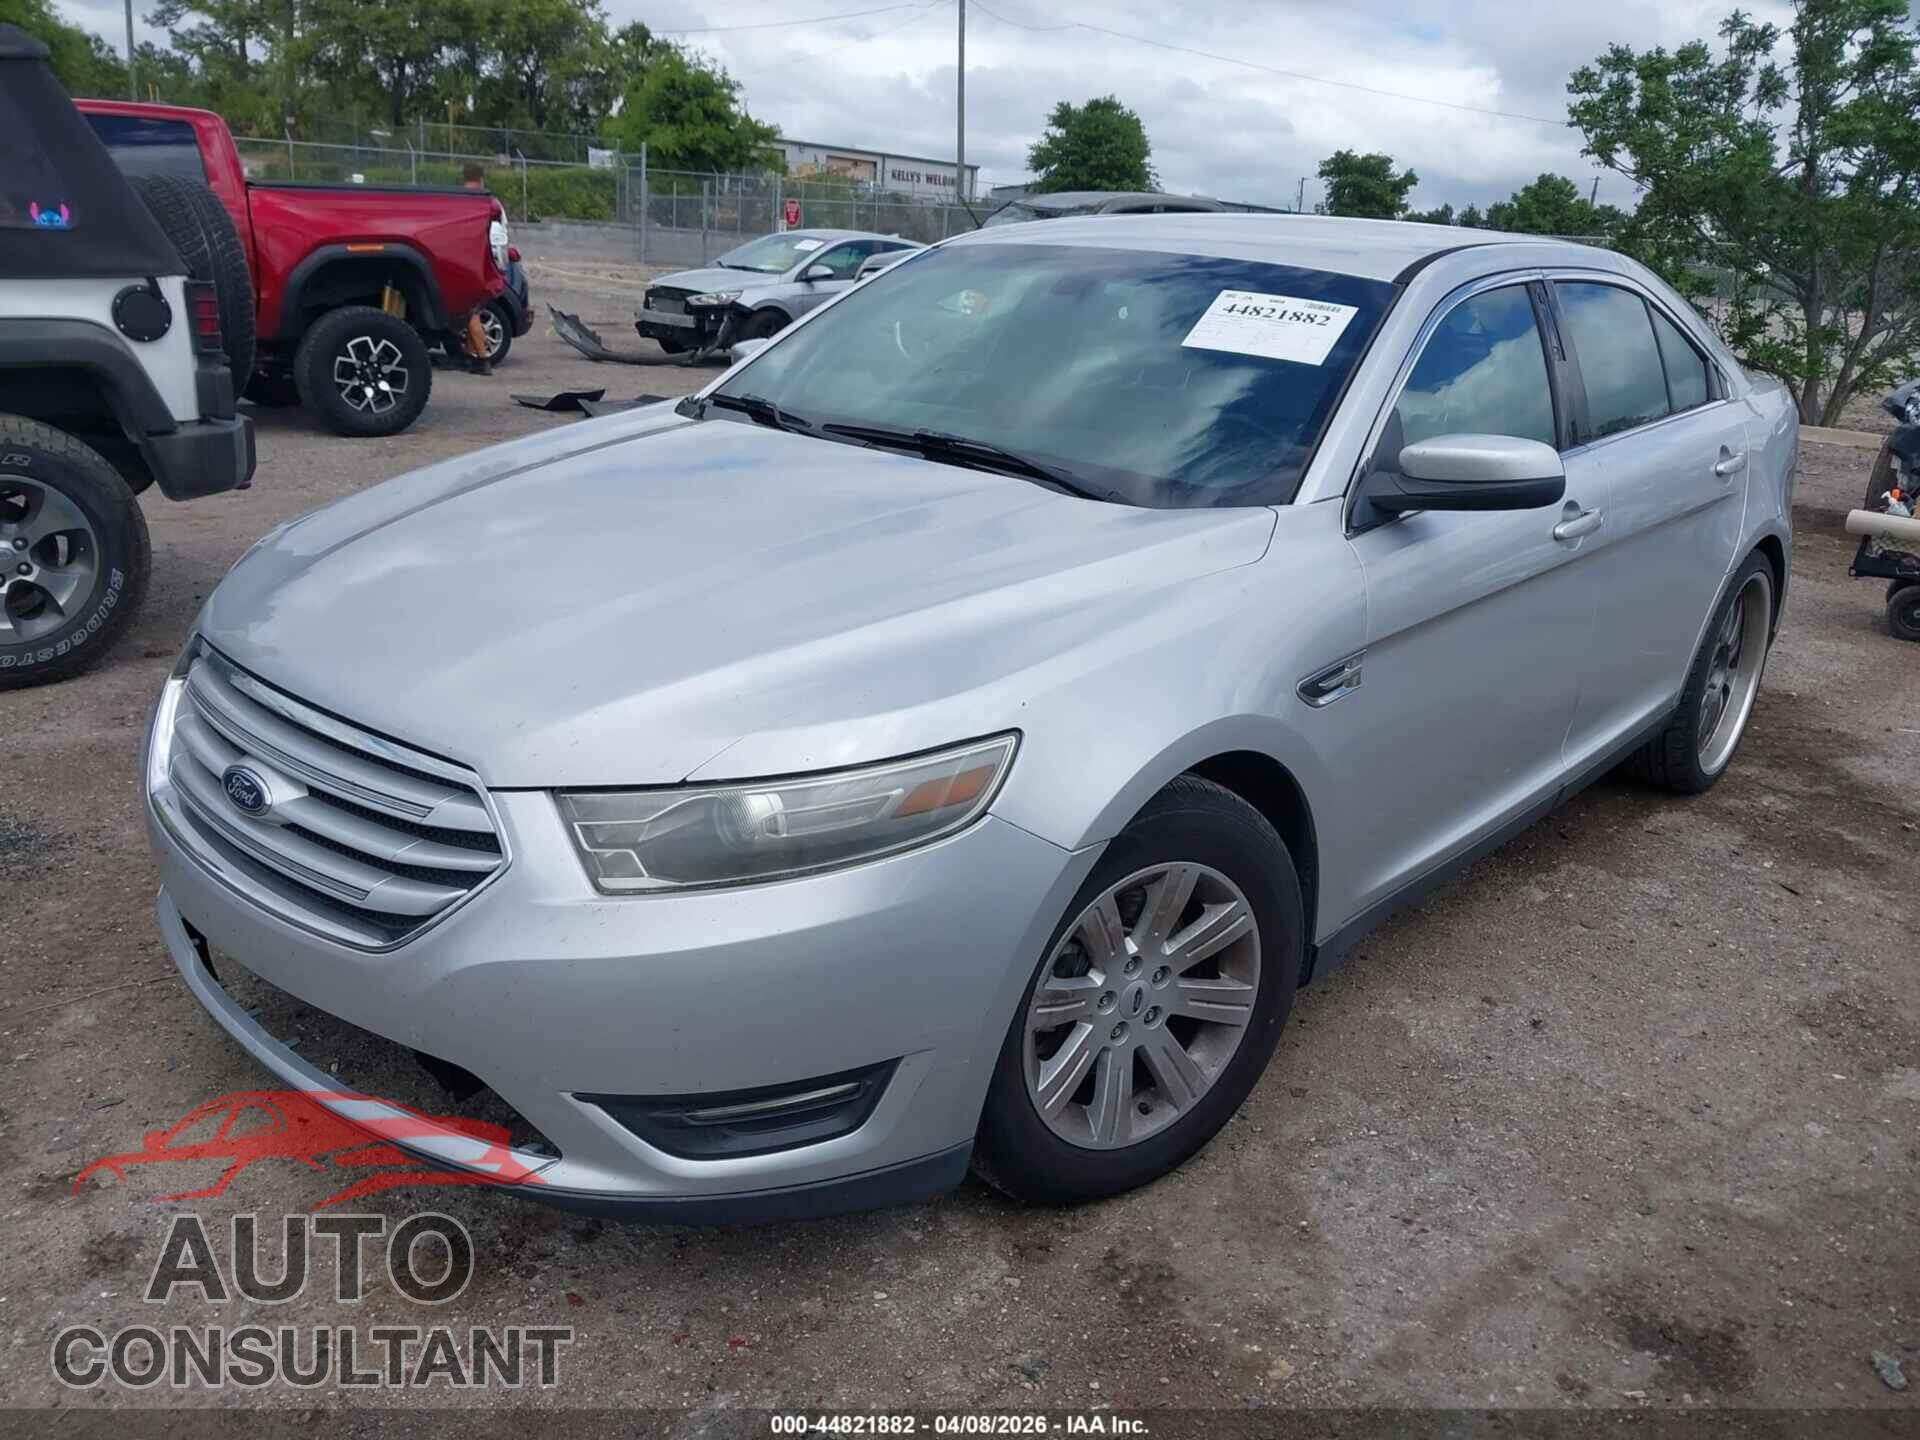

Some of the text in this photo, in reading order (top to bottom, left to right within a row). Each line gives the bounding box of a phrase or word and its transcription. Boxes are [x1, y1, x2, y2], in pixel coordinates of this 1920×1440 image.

[891, 168, 957, 187] KELLY'S WELDIN
[1223, 303, 1331, 327] 44821882
[227, 774, 257, 807] Ford
